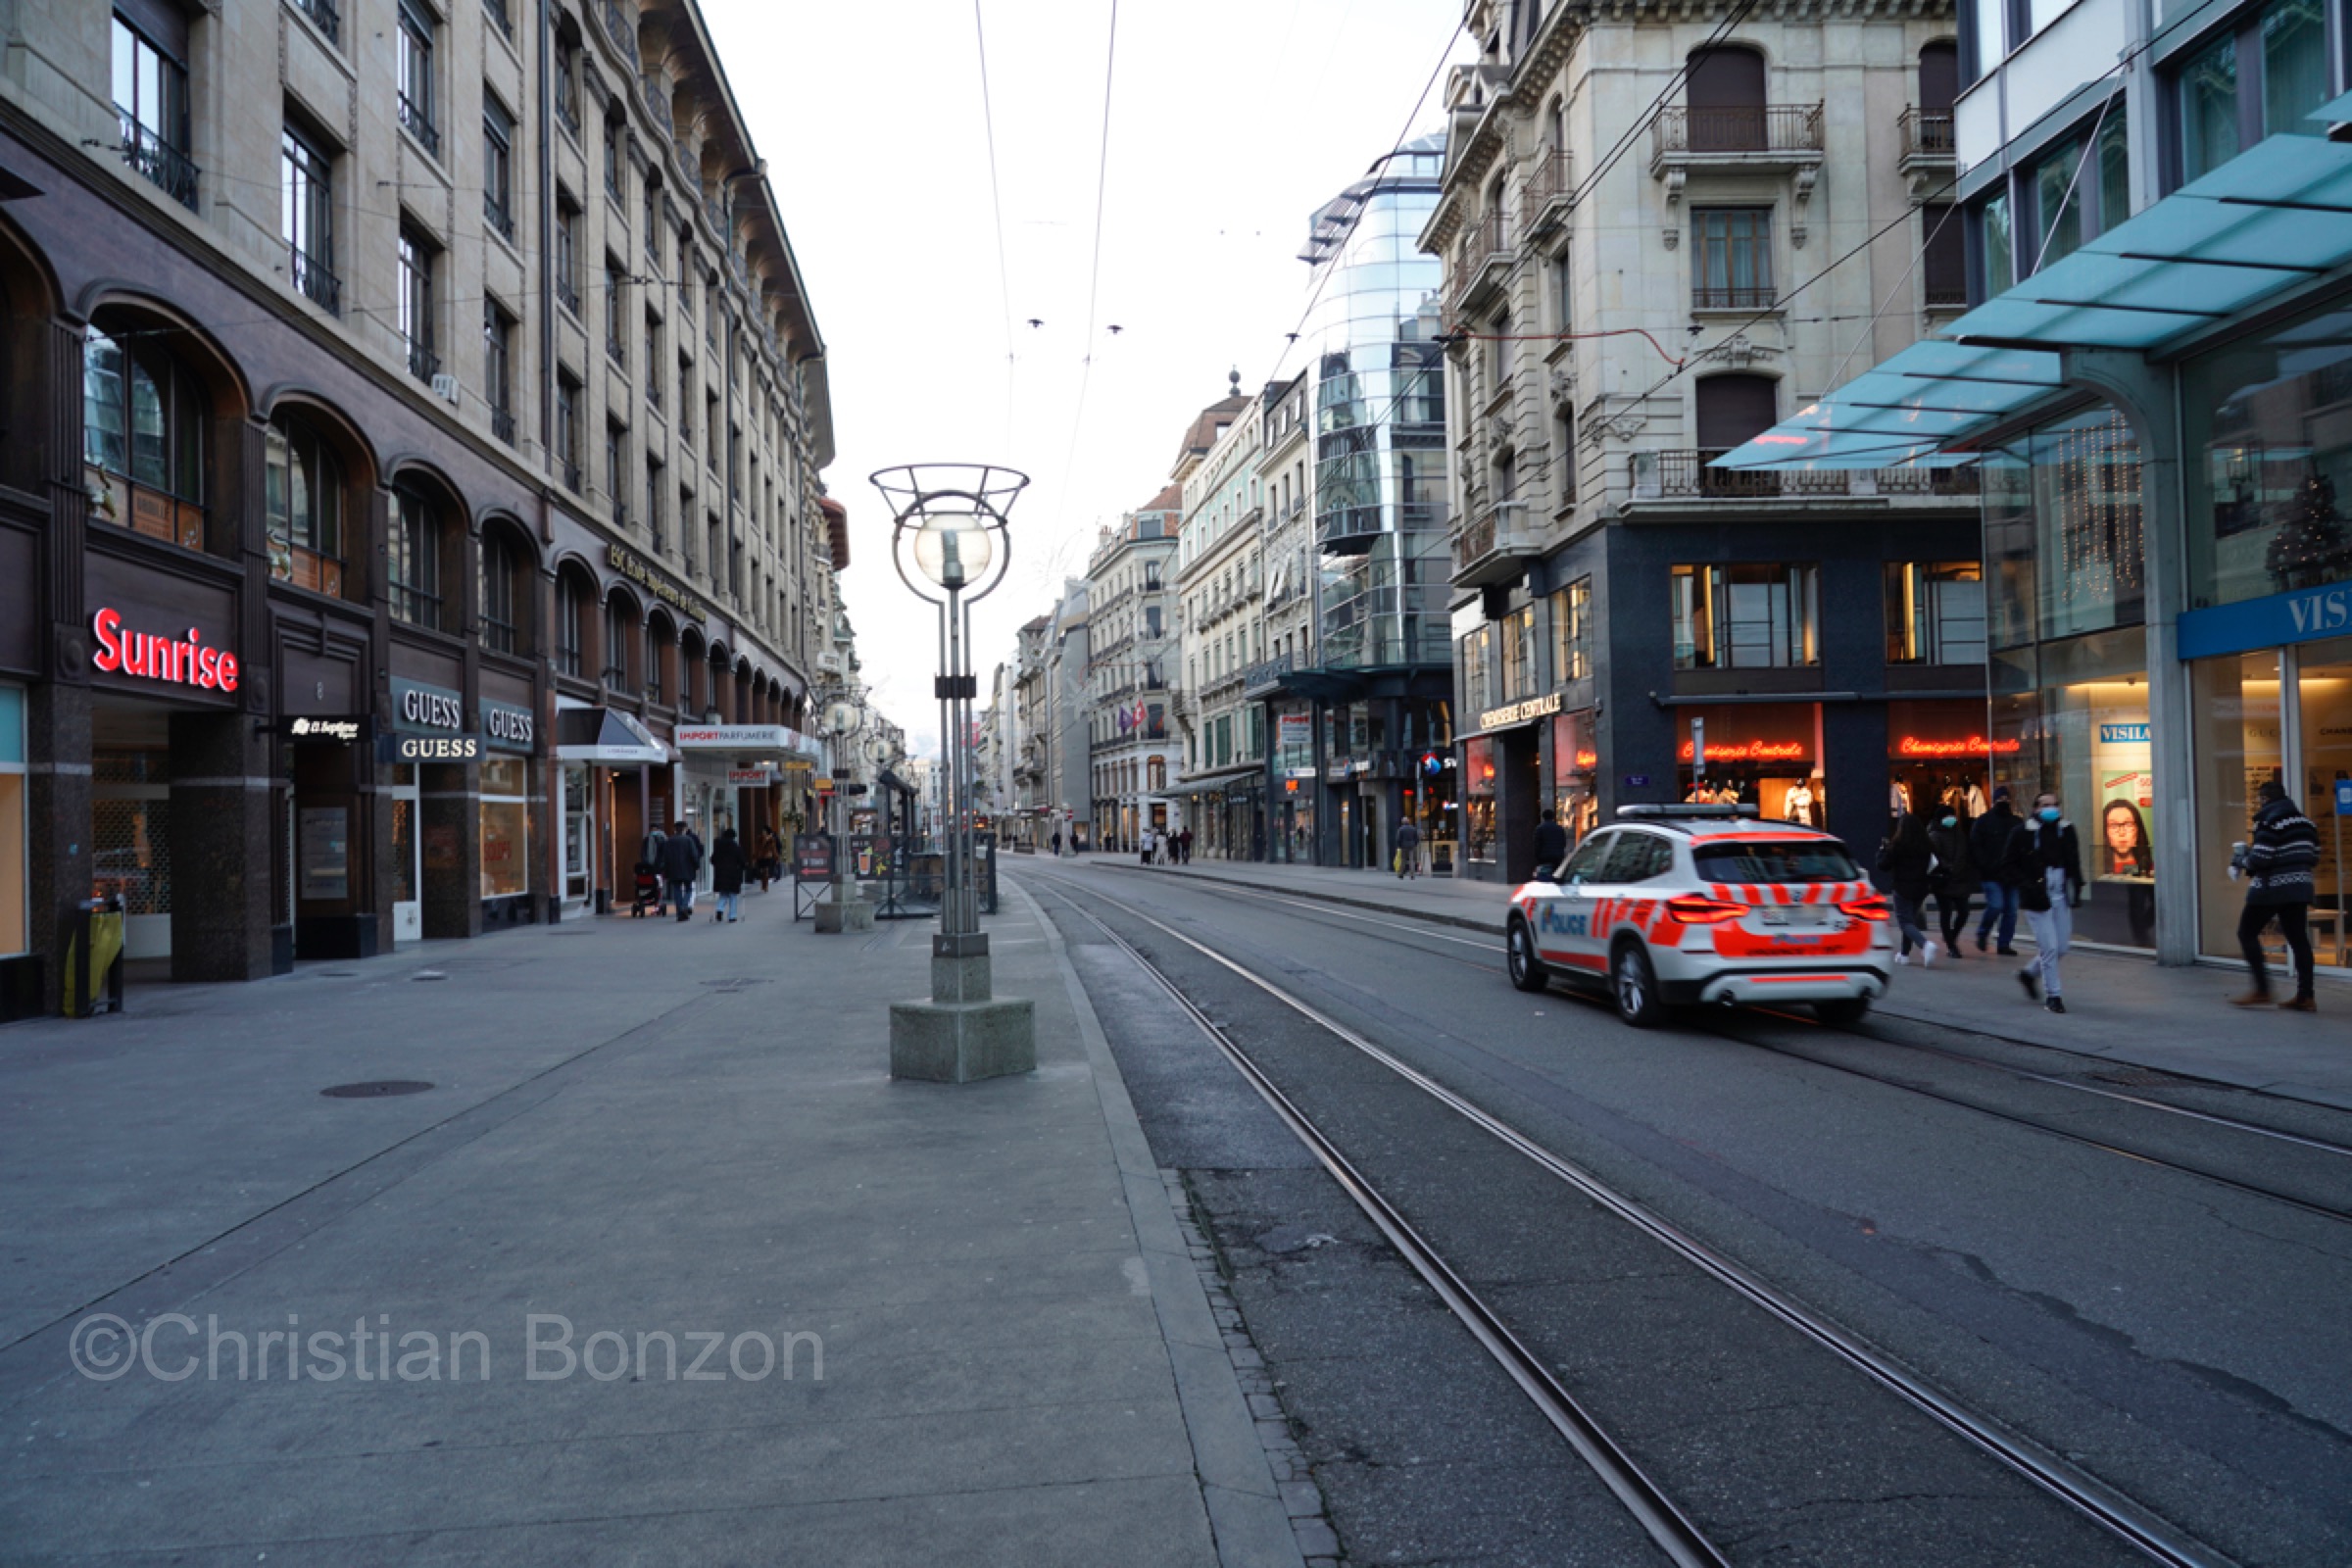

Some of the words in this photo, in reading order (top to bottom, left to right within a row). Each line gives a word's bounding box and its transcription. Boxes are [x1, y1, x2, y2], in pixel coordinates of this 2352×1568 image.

[2288, 590, 2352, 634] VIS
[93, 607, 239, 692] Sunrise
[405, 689, 461, 729] GUESS
[491, 708, 532, 742] GUESS
[401, 738, 477, 758] GUESS
